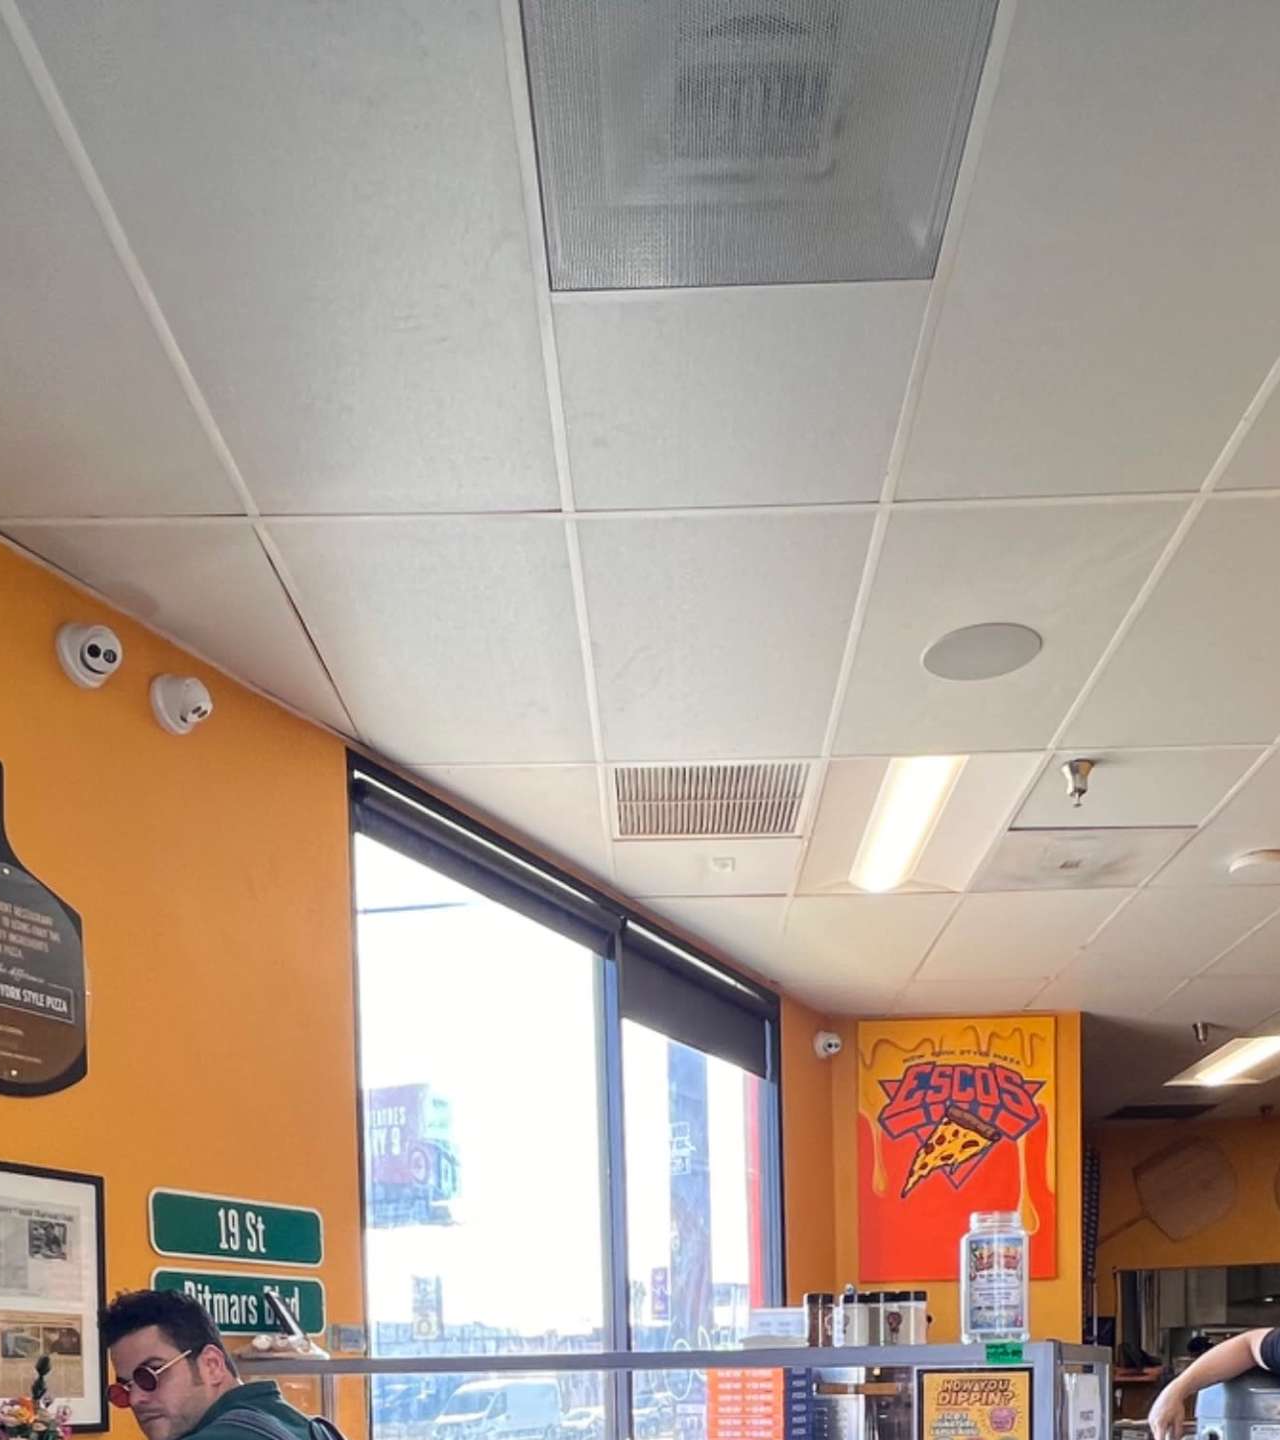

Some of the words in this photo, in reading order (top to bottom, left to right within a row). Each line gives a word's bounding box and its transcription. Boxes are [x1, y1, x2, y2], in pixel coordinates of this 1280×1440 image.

[0, 983, 21, 1001] YORK
[22, 989, 44, 1007] STYLE
[45, 994, 68, 1013] PIZZA
[218, 1208, 242, 1251] 19
[246, 1211, 267, 1253] St
[263, 1285, 300, 1325] Bd
